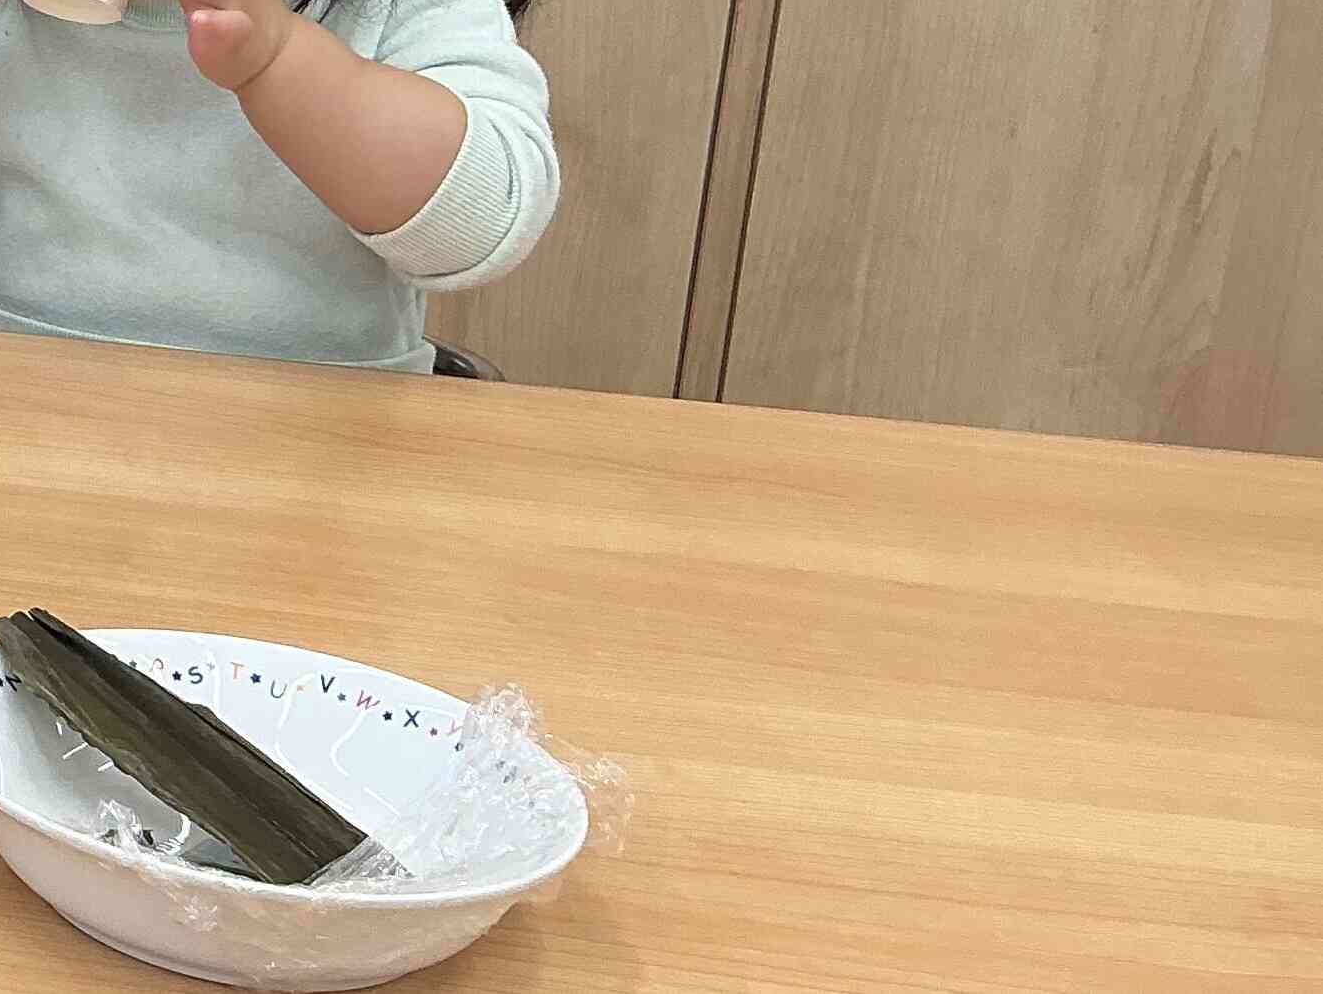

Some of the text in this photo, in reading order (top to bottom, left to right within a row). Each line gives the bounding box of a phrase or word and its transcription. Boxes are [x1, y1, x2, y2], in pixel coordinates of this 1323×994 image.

[187, 665, 204, 684] S
[229, 661, 245, 680] T
[269, 680, 288, 699] U
[320, 673, 336, 694] V
[355, 689, 381, 710] W
[402, 708, 421, 729] X
